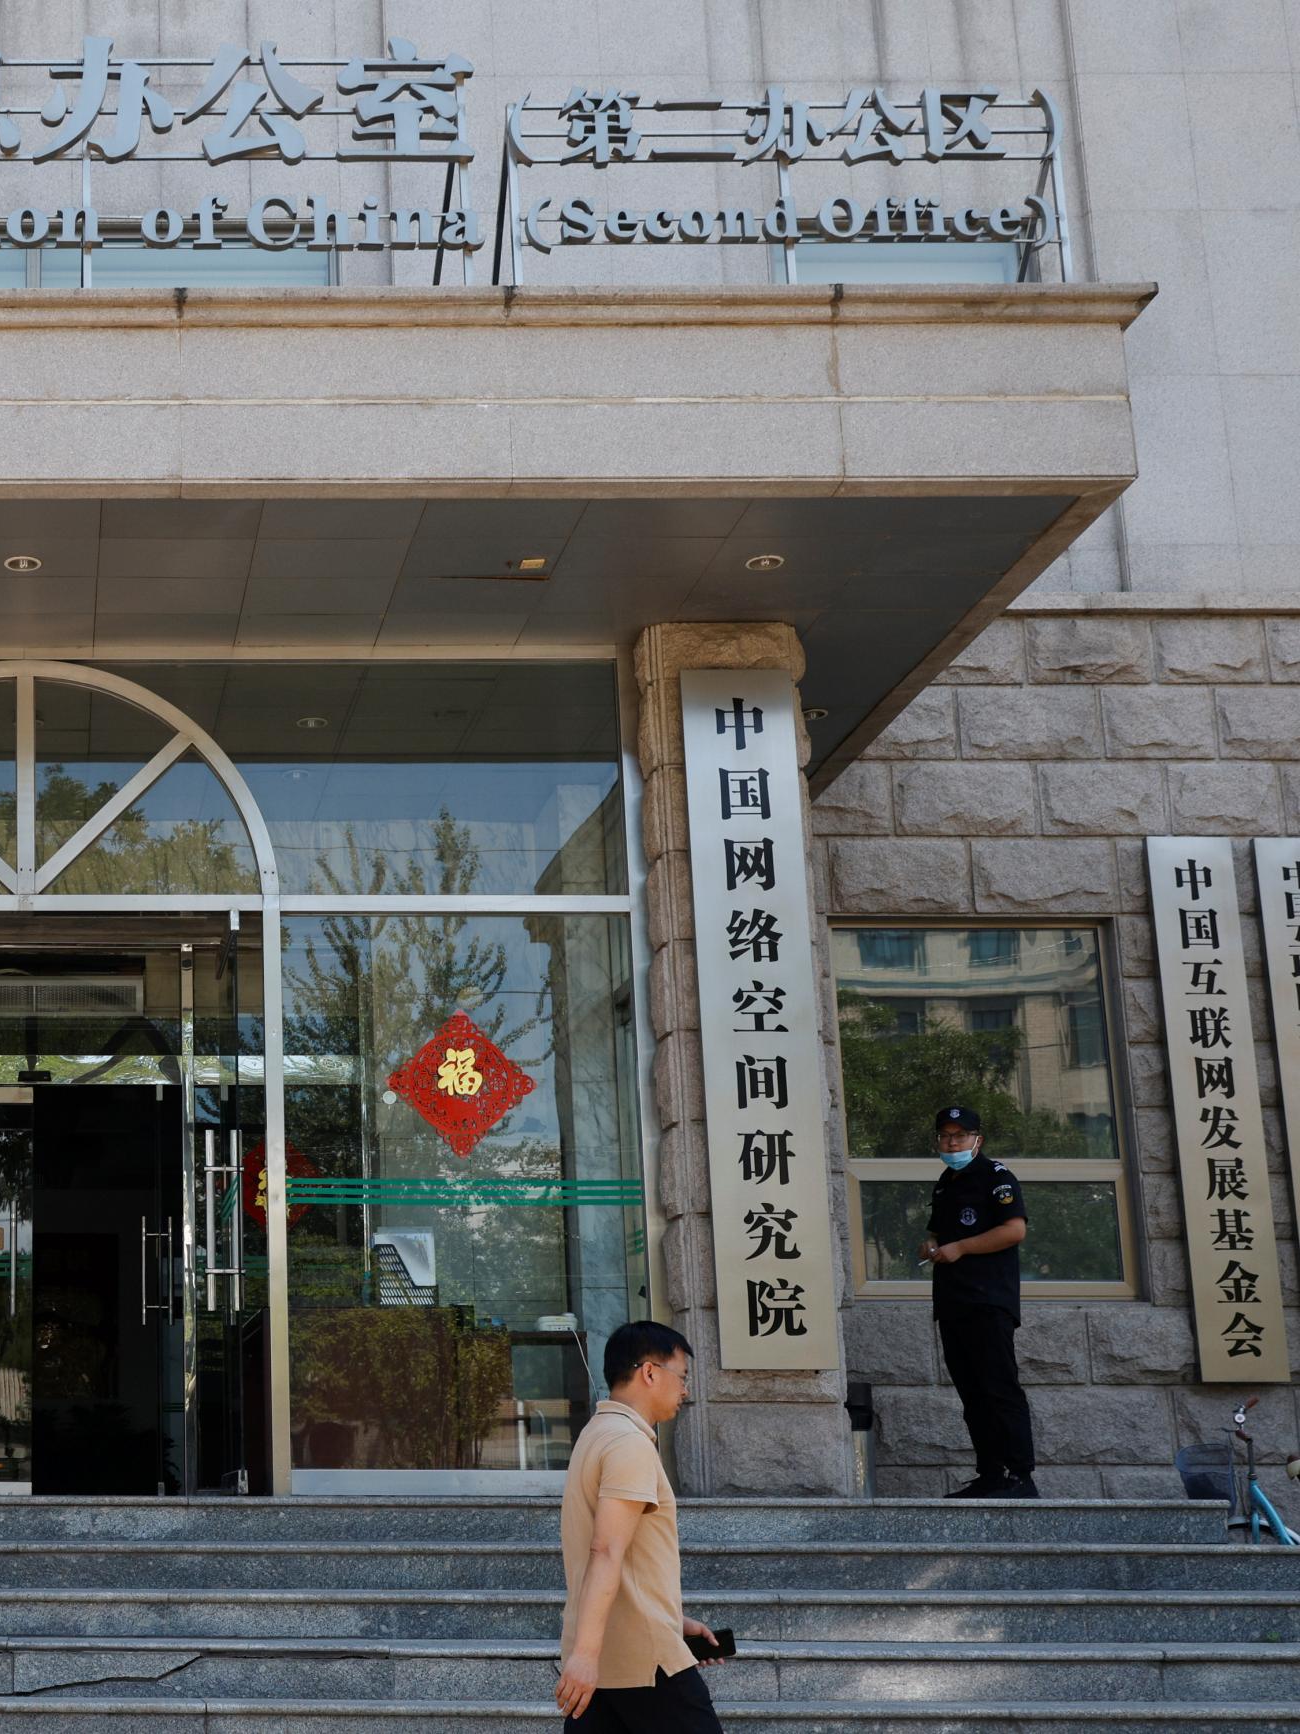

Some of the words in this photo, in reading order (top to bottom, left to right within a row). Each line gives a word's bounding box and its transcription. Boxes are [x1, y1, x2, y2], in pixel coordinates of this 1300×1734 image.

[141, 197, 229, 251] of
[247, 195, 487, 252] China
[525, 196, 801, 254] (Second
[815, 195, 1056, 252] Office)
[438, 1048, 483, 1096] 福
[714, 697, 808, 1337] 中国网络空间研究院
[1174, 858, 1265, 1358] 中国互联网发展基金会
